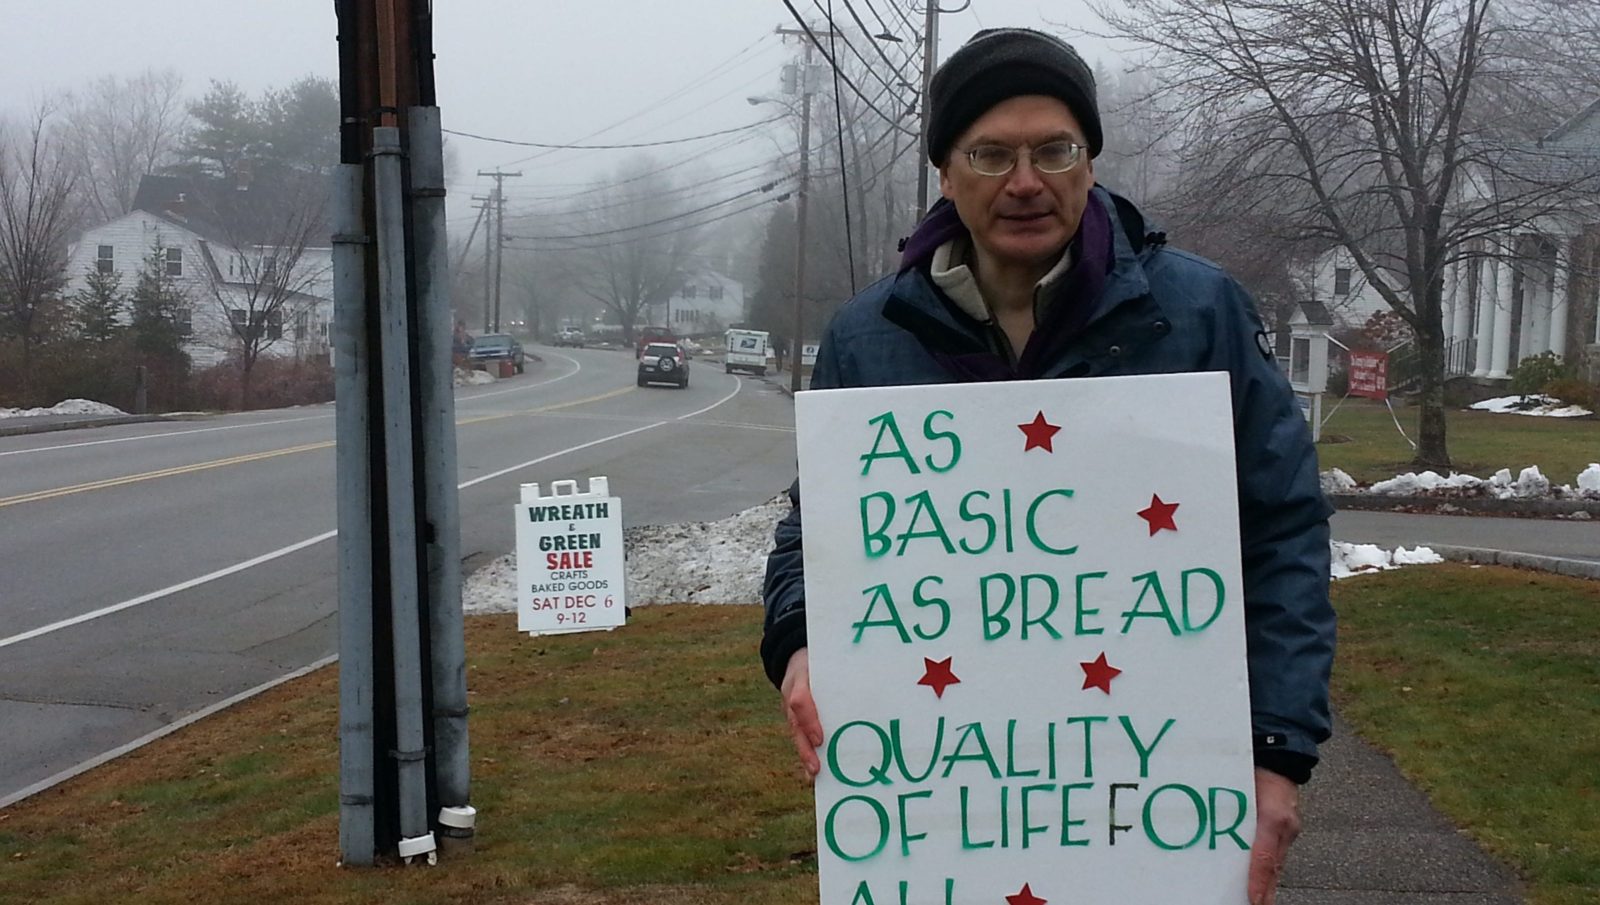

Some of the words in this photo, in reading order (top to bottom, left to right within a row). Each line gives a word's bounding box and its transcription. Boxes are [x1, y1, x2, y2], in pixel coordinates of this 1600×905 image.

[859, 409, 963, 477] AS
[528, 502, 609, 522] WREATH
[858, 488, 1079, 559] BASIC
[539, 533, 601, 551] GREEN
[546, 551, 593, 570] SALE
[550, 570, 589, 581] CRAFTS
[531, 583, 565, 593] BAKED
[568, 580, 608, 590] GOODS
[532, 597, 560, 611] SAT
[565, 595, 596, 609] DEC
[604, 594, 613, 608] 6
[851, 575, 952, 646] AS
[979, 567, 1226, 644] BREAD
[556, 612, 586, 625] 9-12
[826, 715, 1177, 788] QUALITY
[824, 789, 933, 863] OF
[959, 782, 1095, 851] LIFE
[1109, 782, 1251, 851] FOR
